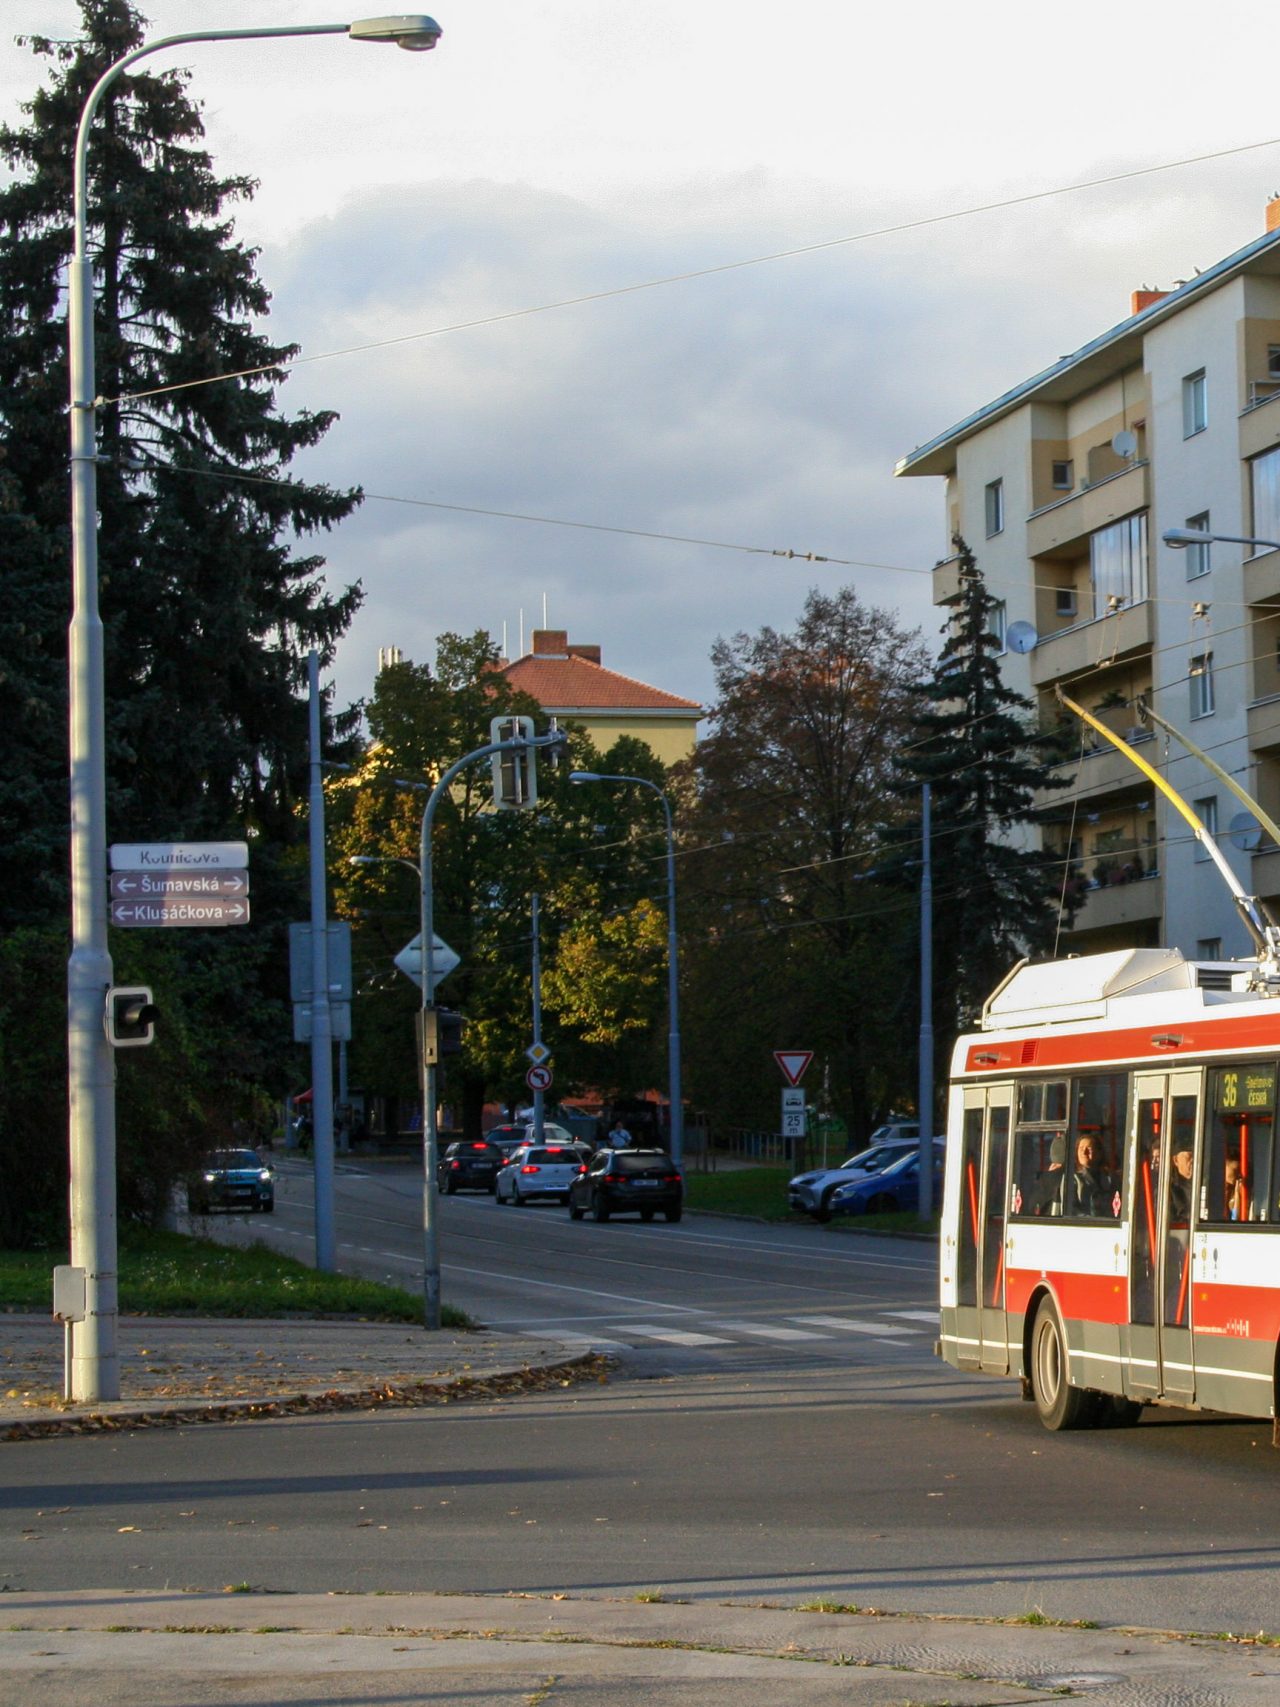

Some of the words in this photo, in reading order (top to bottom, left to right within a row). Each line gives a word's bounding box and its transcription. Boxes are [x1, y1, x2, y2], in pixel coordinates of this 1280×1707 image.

[141, 875, 219, 892] Šumavská
[135, 905, 223, 920] Klusáčkova
[1223, 1073, 1238, 1107] 36
[787, 1115, 800, 1127] 25
